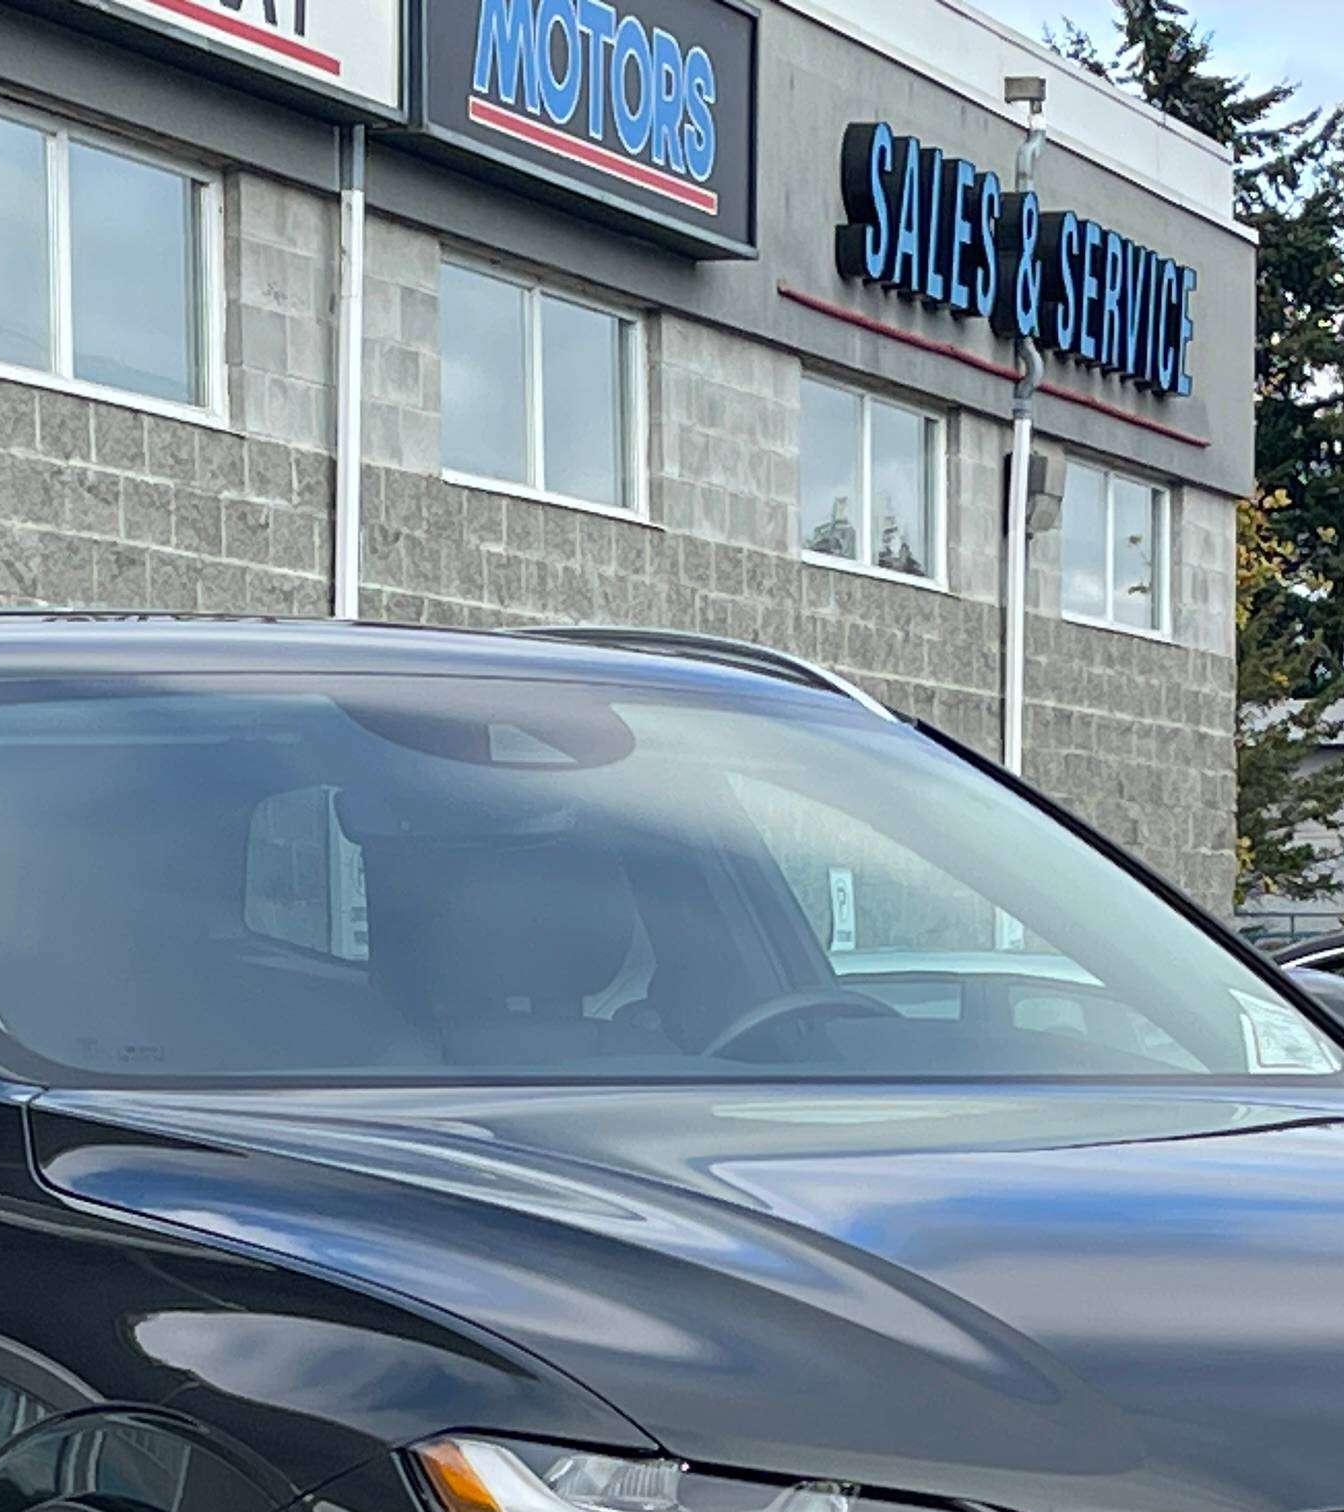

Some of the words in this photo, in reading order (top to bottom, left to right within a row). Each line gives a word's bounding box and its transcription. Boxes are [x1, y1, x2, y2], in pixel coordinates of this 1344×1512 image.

[472, 0, 716, 183] MOTORS
[860, 121, 1001, 318] SALES
[1013, 190, 1042, 339] &
[1057, 211, 1198, 397] SERVICE
